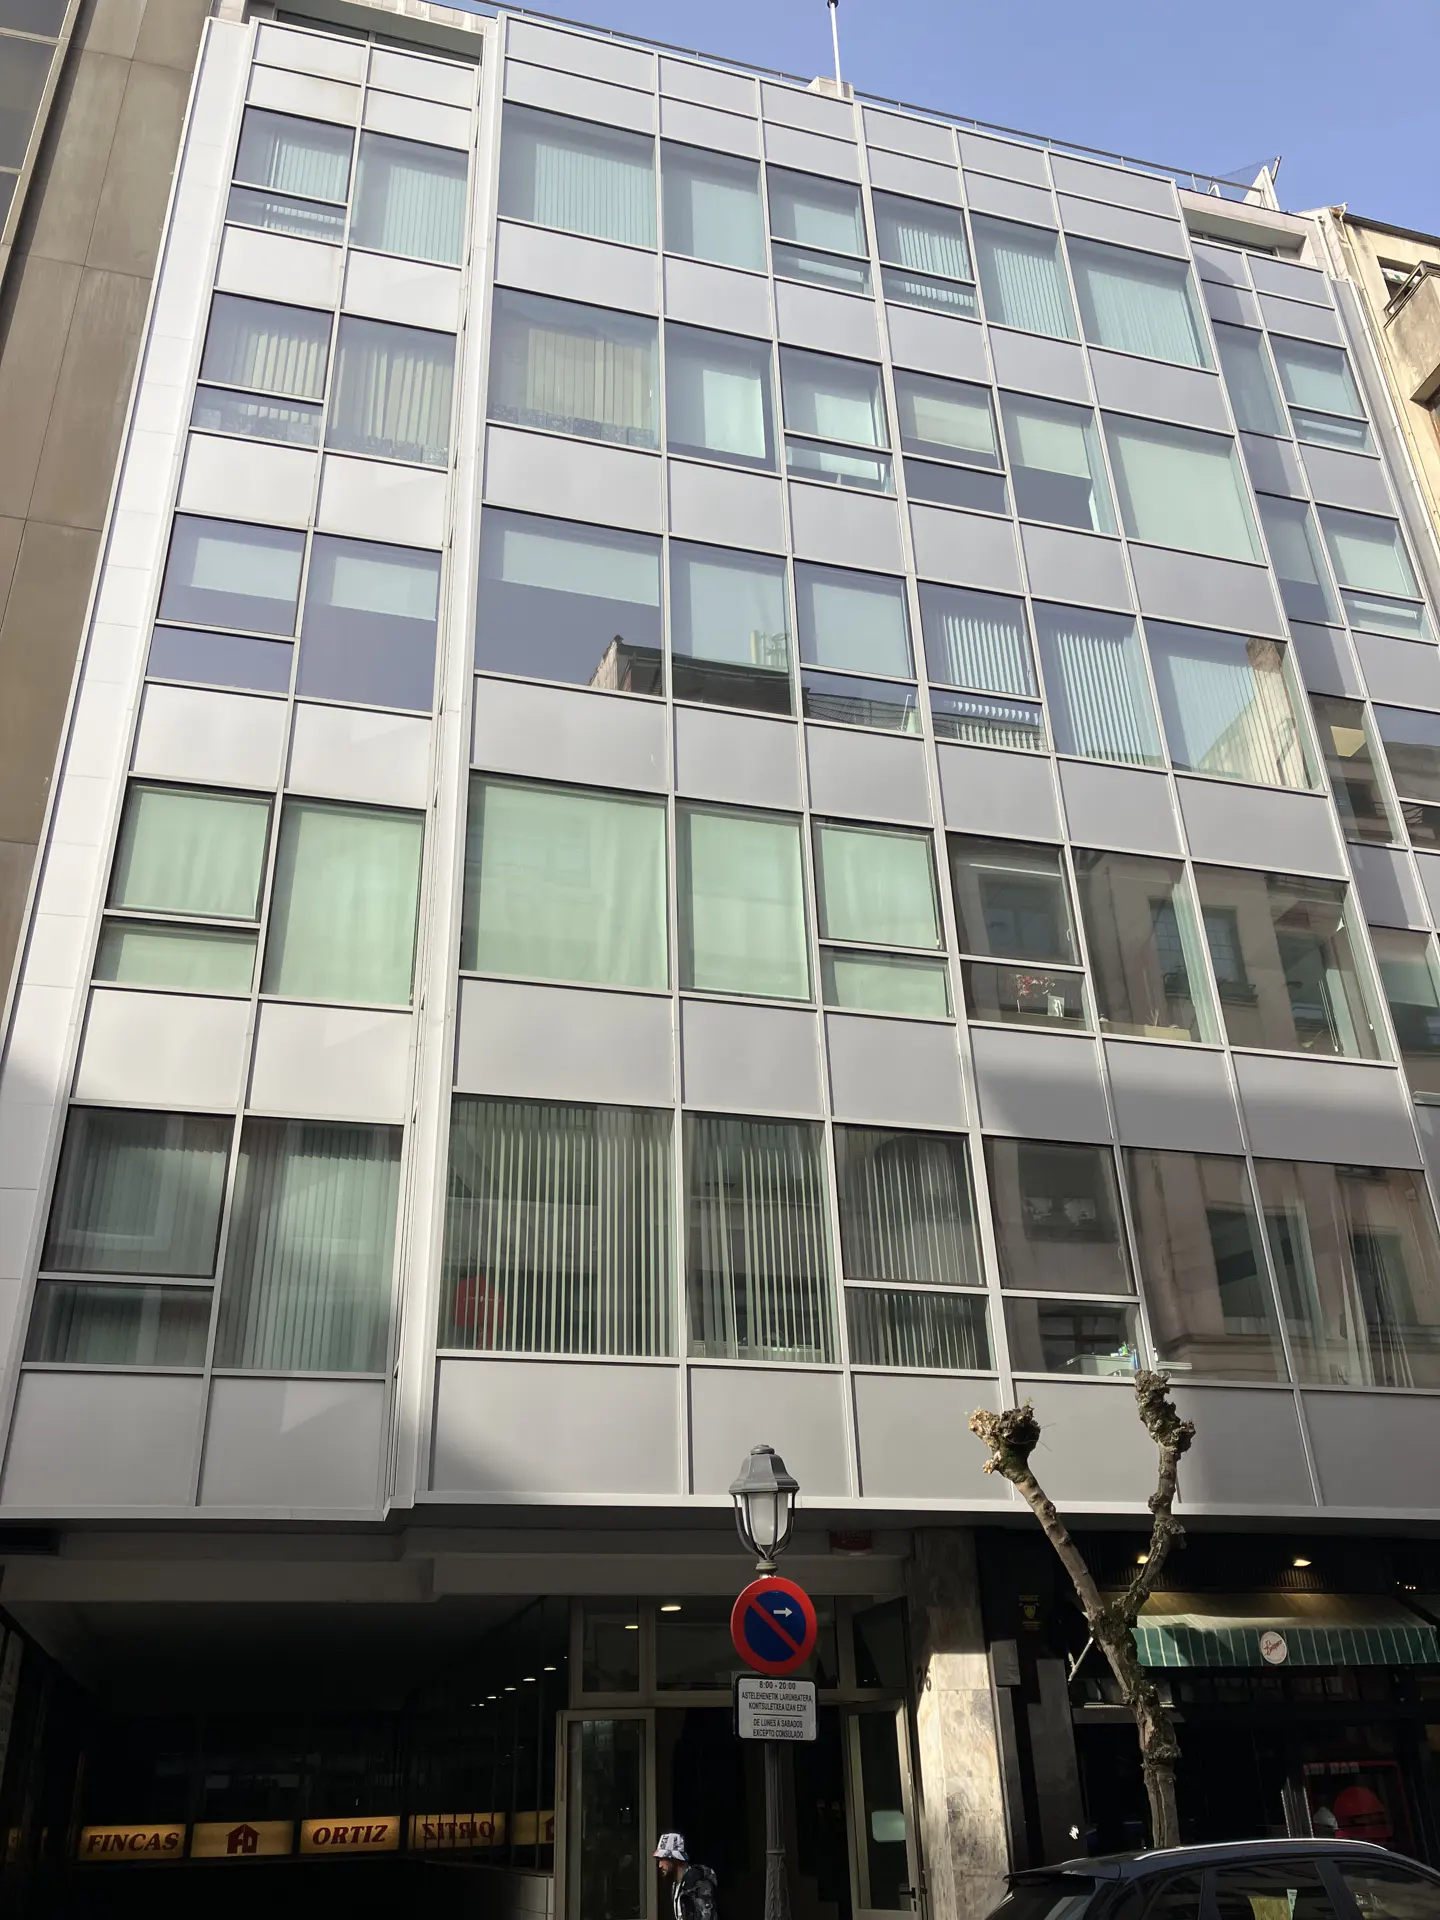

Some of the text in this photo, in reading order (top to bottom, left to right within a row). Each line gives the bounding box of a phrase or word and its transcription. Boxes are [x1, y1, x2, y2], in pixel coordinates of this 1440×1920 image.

[916, 1665, 932, 1693] 26
[779, 1682, 796, 1690] 20:00
[742, 1692, 778, 1700] ASTELEHENETIK
[749, 1702, 785, 1711] KONTSULETXEA
[785, 1703, 796, 1711] IZAN
[761, 1719, 776, 1727] LUNES
[753, 1729, 803, 1738] EXCEPTO CONSULADO
[86, 1832, 179, 1853] FINCAS
[313, 1825, 388, 1845] ORTIZ
